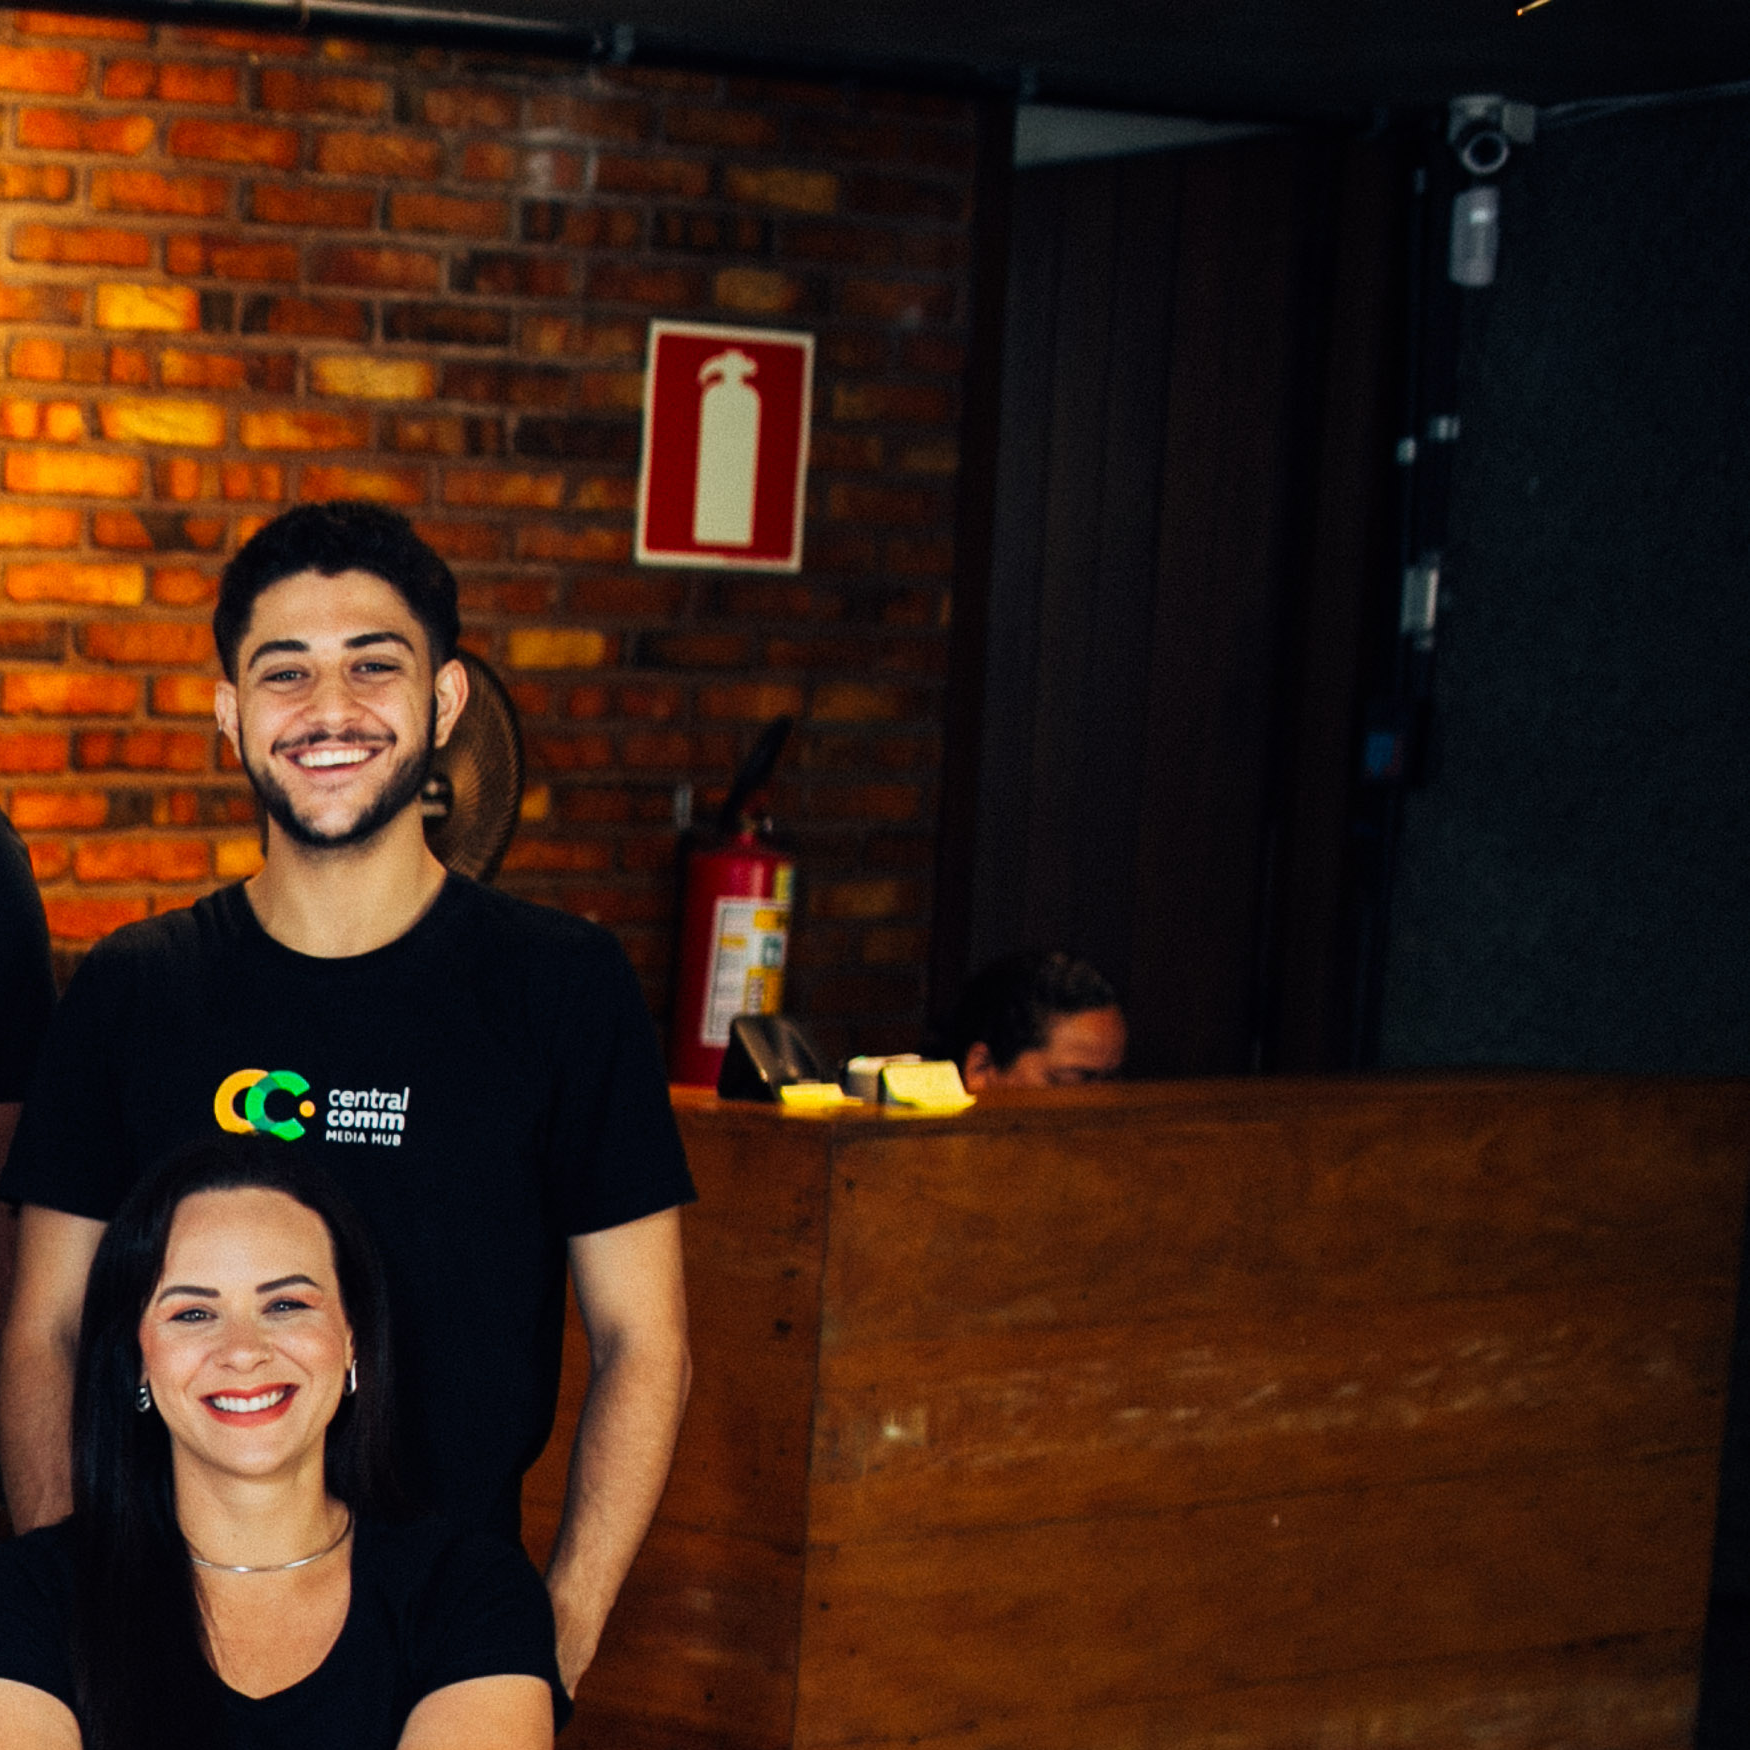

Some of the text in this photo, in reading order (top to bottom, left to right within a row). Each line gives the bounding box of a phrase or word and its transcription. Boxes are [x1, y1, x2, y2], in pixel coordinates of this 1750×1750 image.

[328, 1086, 410, 1111] central
[327, 1109, 405, 1131] comm
[326, 1130, 401, 1146] MEDIA HUB
